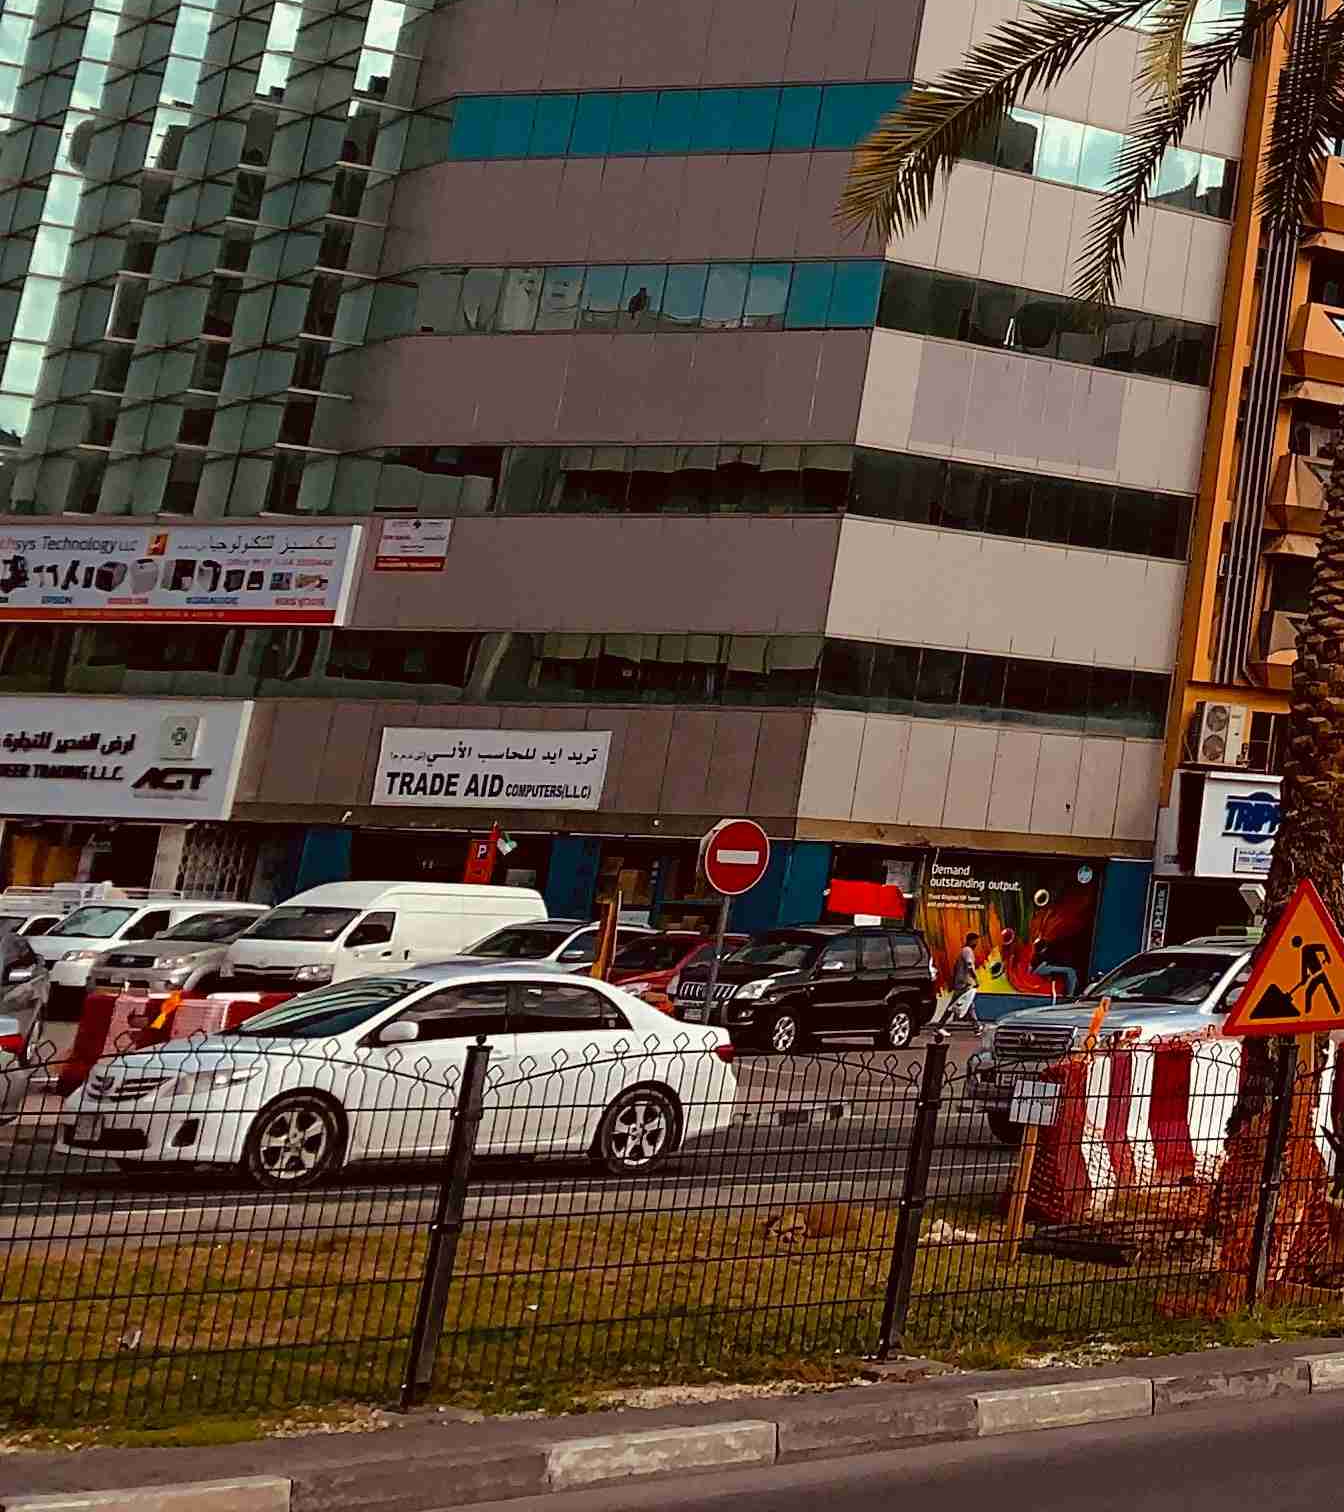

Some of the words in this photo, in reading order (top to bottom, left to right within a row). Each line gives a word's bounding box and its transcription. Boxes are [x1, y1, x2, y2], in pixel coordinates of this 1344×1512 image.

[42, 536, 115, 554] Technology
[386, 771, 460, 797] TRADE
[464, 773, 504, 798] AID
[932, 863, 970, 876] Demand
[930, 877, 984, 891] outstanding
